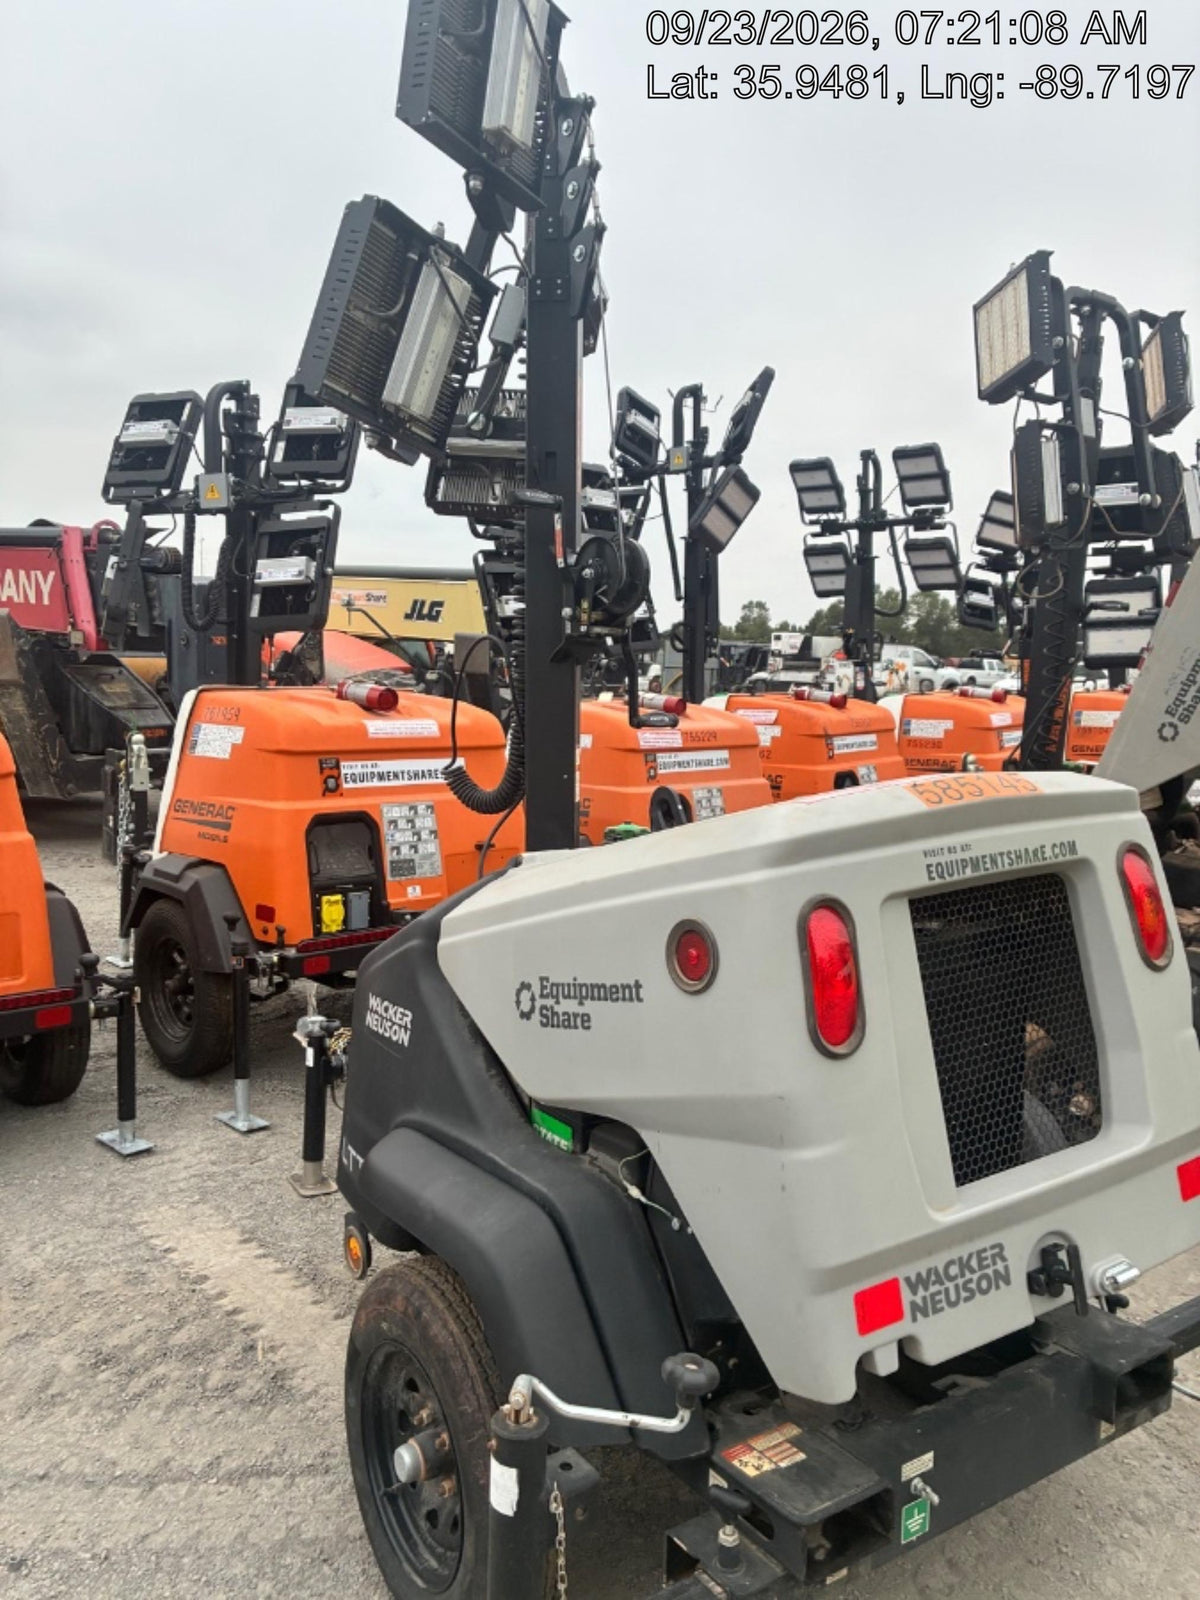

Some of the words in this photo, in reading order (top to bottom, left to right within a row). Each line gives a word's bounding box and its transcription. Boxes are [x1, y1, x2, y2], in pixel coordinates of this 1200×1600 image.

[1, 568, 56, 606] ANY
[403, 598, 445, 623] JLG
[910, 773, 1038, 805] 585145
[173, 799, 235, 821] GENERAC
[924, 840, 1079, 882] EQUIPMENTSHARE.COM
[538, 976, 644, 1006] Equipment
[365, 1010, 411, 1048] NEUSON
[368, 992, 413, 1029] WACKER
[538, 1004, 592, 1031] Share
[904, 1242, 1008, 1297] WACKER
[909, 1263, 1012, 1324] NEUSON
